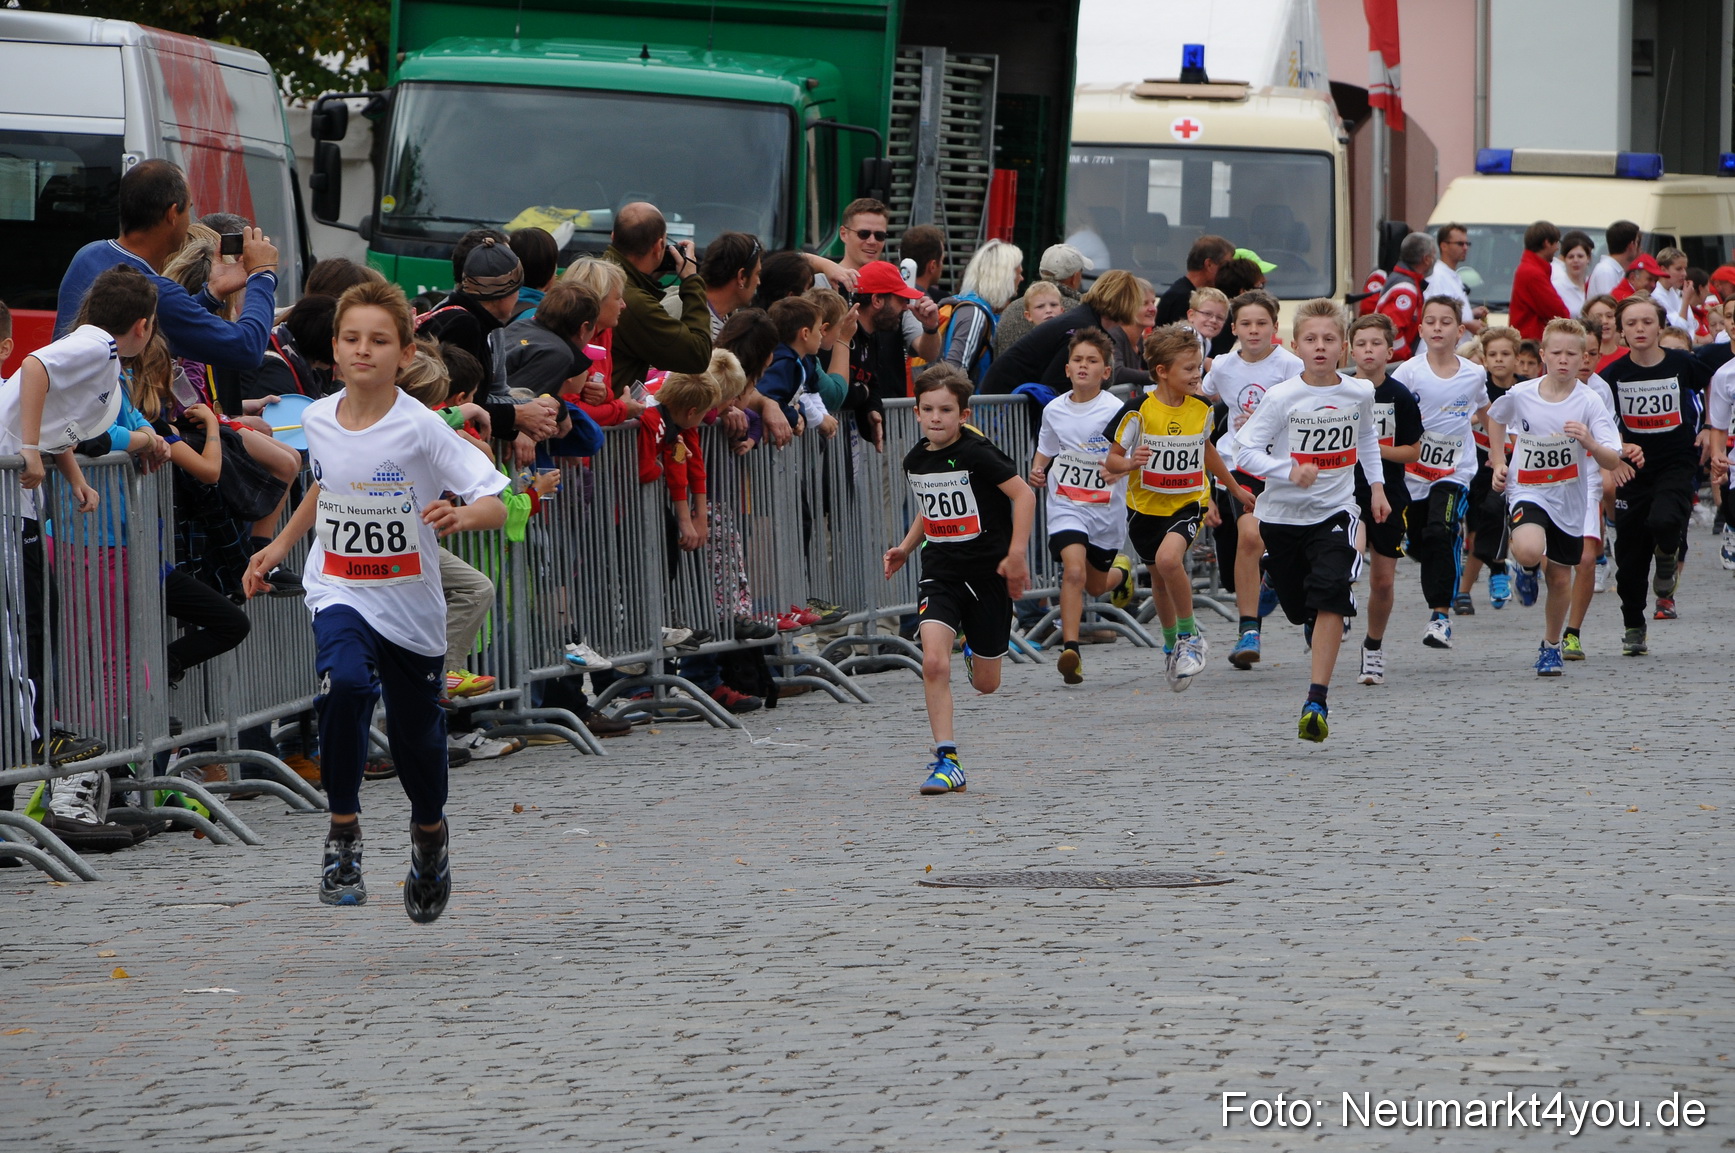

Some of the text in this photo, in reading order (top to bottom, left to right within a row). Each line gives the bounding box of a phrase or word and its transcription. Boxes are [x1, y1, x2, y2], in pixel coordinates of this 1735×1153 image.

[1081, 155, 1089, 164] 4
[1638, 385, 1669, 393] Neumarkt
[1623, 393, 1673, 415] 7230
[1290, 415, 1351, 425] PARTL Neumarkt
[1636, 418, 1664, 428] Niklas
[1143, 439, 1198, 448] PARTL Neumarkt
[1297, 425, 1354, 452] 7220
[1520, 437, 1568, 448] PARTL Neumarkt
[1059, 453, 1075, 462] ARTL
[1149, 448, 1200, 471] 7084
[1420, 442, 1456, 467] 064
[1523, 447, 1572, 469] 7386
[1312, 456, 1341, 467] David
[1059, 463, 1106, 489] 7378
[1160, 477, 1188, 487] Jonas
[924, 480, 958, 489] Neumarkt
[319, 500, 398, 515] PARTL Neumarkt
[916, 491, 968, 518] 7260
[929, 523, 958, 535] Simon
[325, 518, 408, 554] 7268
[345, 561, 389, 576] Jonas
